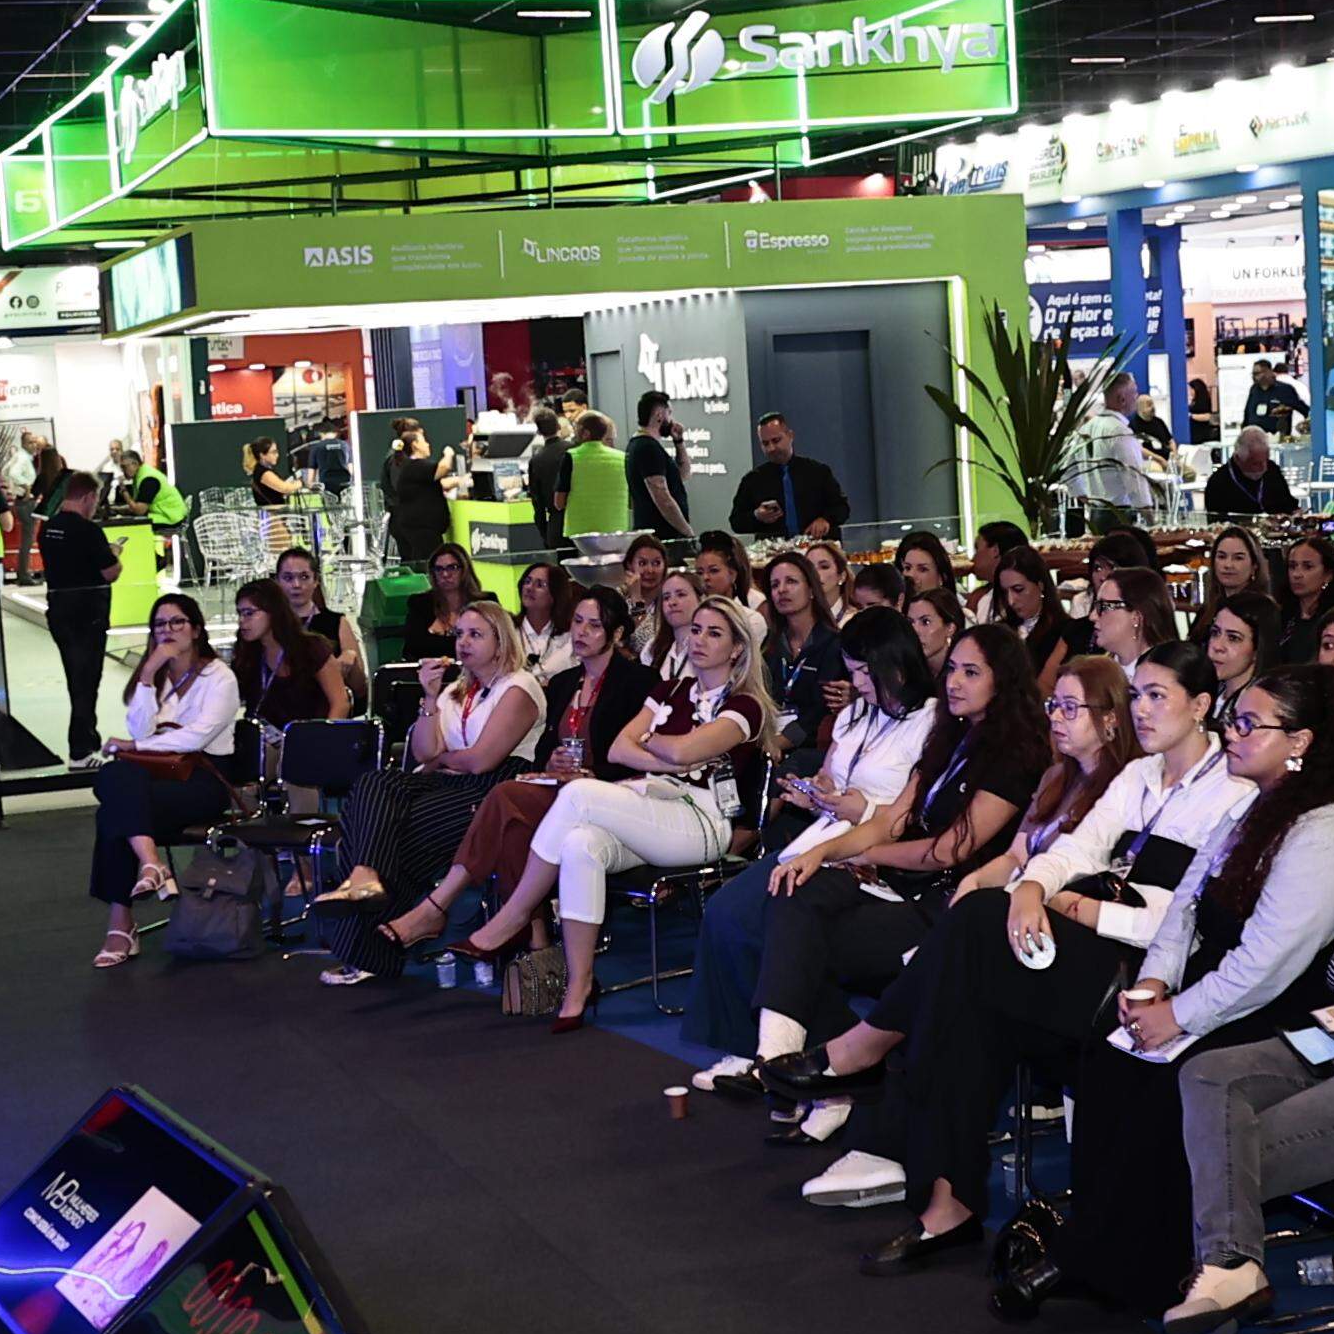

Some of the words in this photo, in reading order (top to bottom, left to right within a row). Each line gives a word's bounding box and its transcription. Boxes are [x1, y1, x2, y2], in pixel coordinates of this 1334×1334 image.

[740, 17, 998, 74] Sankhya
[760, 231, 830, 251] Espresso
[324, 245, 374, 266] ASIS
[536, 244, 601, 264] LINCROS
[1233, 267, 1251, 280] UN
[1047, 294, 1072, 307] Aqui
[1080, 295, 1102, 304] sem
[1045, 308, 1057, 324] O
[1070, 326, 1100, 342] eças
